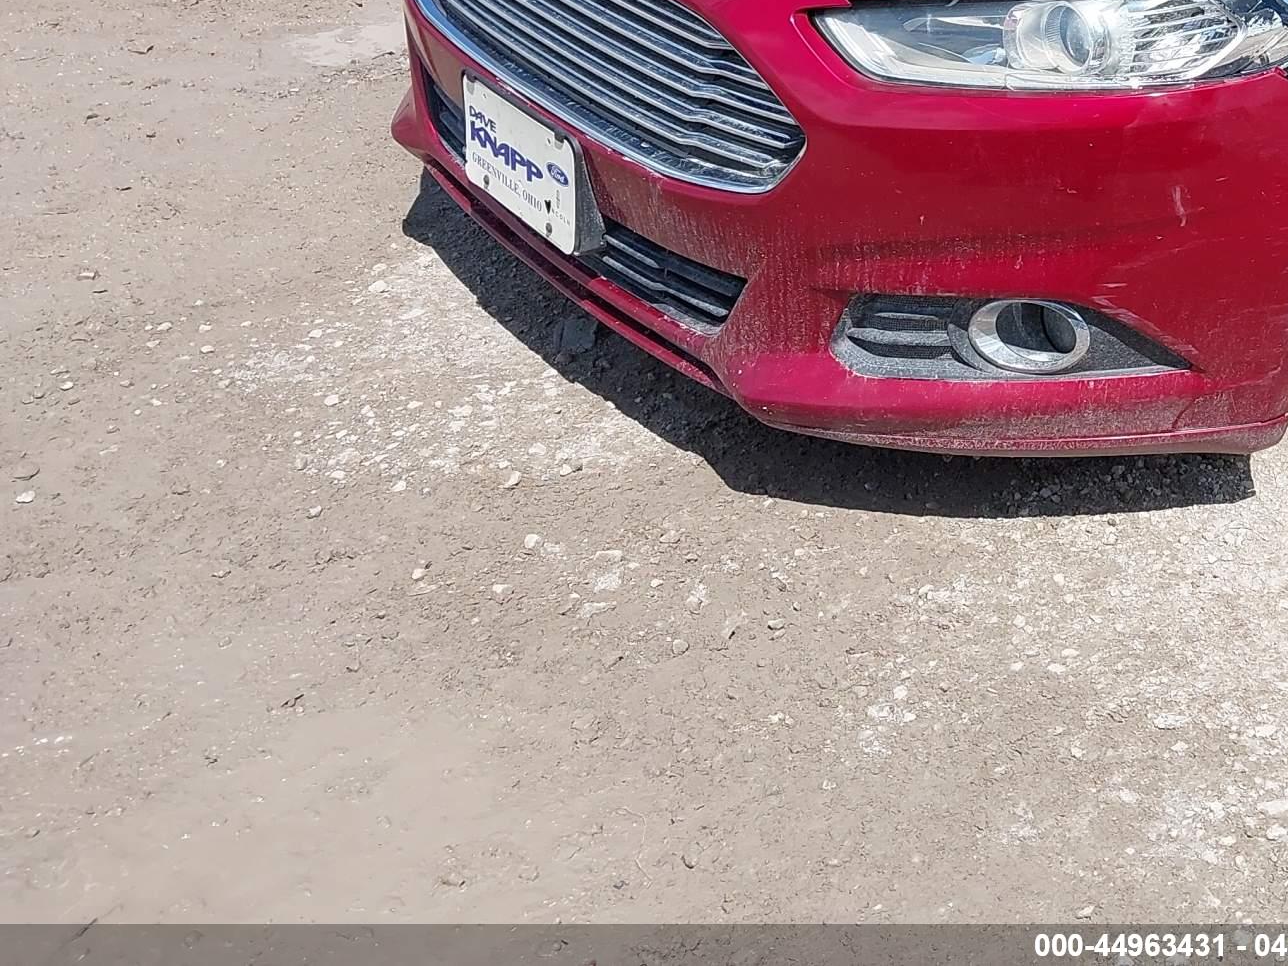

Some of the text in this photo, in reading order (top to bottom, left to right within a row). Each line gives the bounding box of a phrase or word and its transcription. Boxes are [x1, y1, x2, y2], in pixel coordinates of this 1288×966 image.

[469, 105, 497, 134] DAVE
[470, 120, 544, 183] KNAPP
[472, 152, 542, 212] GREENVILLE, OHIO
[549, 164, 567, 185] Ford
